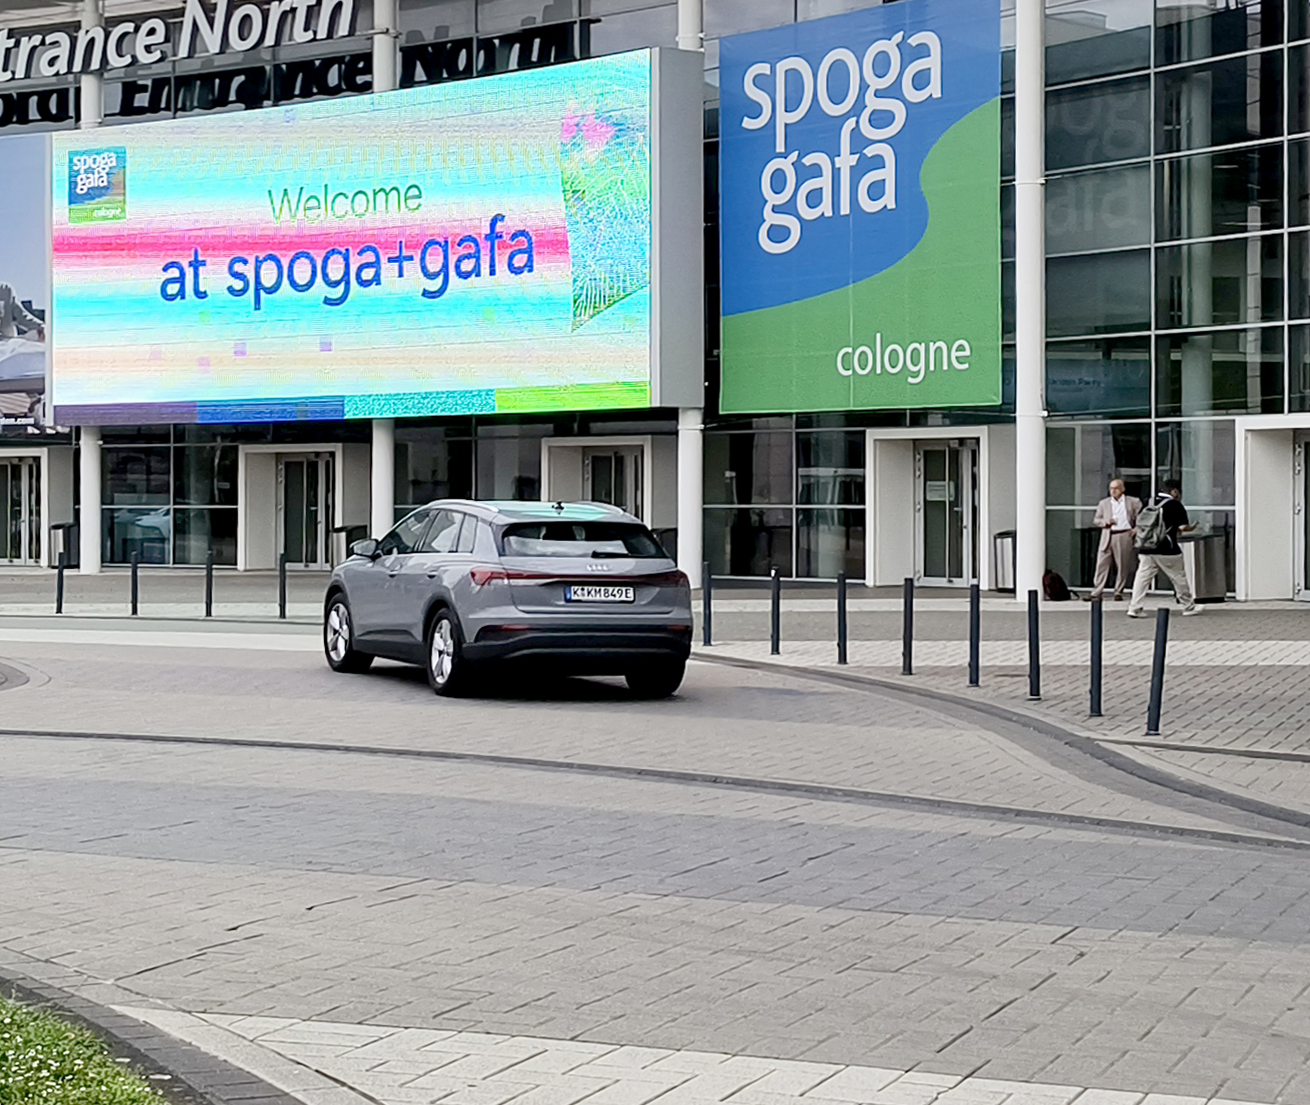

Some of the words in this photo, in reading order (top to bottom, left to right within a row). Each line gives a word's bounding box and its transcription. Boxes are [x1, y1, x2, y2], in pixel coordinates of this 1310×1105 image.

[741, 30, 943, 153] spoga
[72, 151, 118, 175] spoga
[76, 168, 109, 195] gafa
[757, 116, 898, 255] gafa
[266, 180, 424, 226] Welcome
[159, 247, 208, 302] at
[226, 212, 536, 311] spoga+gafa
[836, 333, 972, 385] cologne
